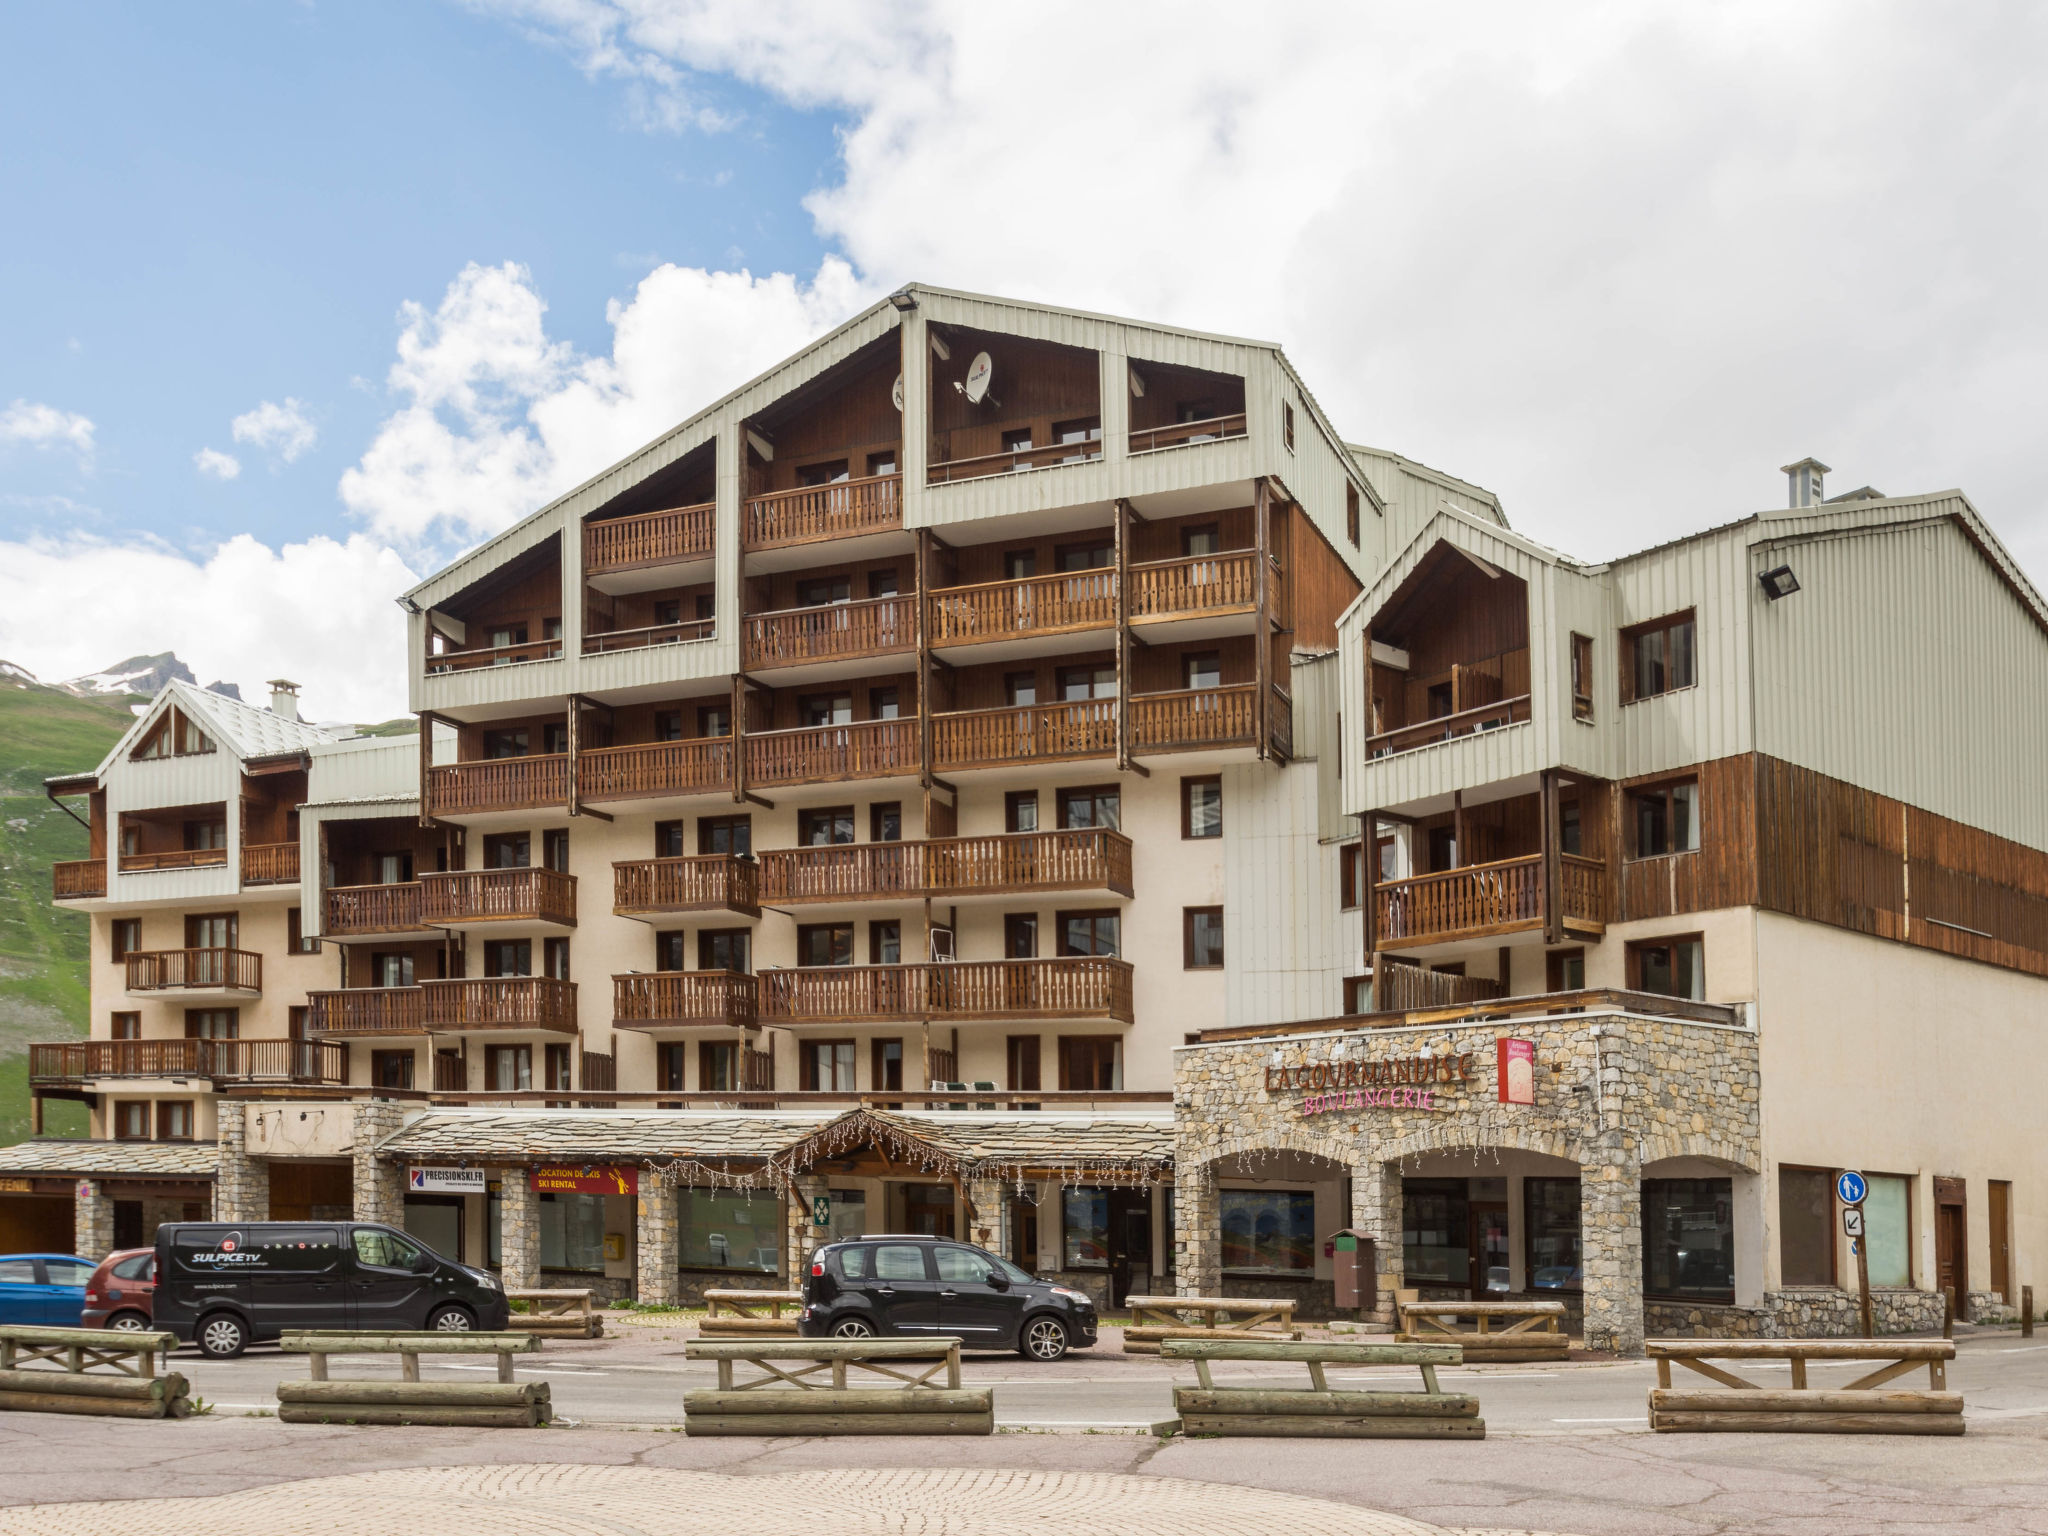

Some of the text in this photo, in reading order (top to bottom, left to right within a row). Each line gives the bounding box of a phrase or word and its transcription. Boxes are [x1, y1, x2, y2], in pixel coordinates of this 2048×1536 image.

[1265, 1052, 1474, 1091] LA GOURMANDISE
[1304, 1088, 1436, 1116] BOULANGERIE
[425, 1170, 484, 1182] PRECISIONSKI.FR
[538, 1180, 577, 1189] SKI RENTAL
[192, 1253, 261, 1262] SULPICE TV
